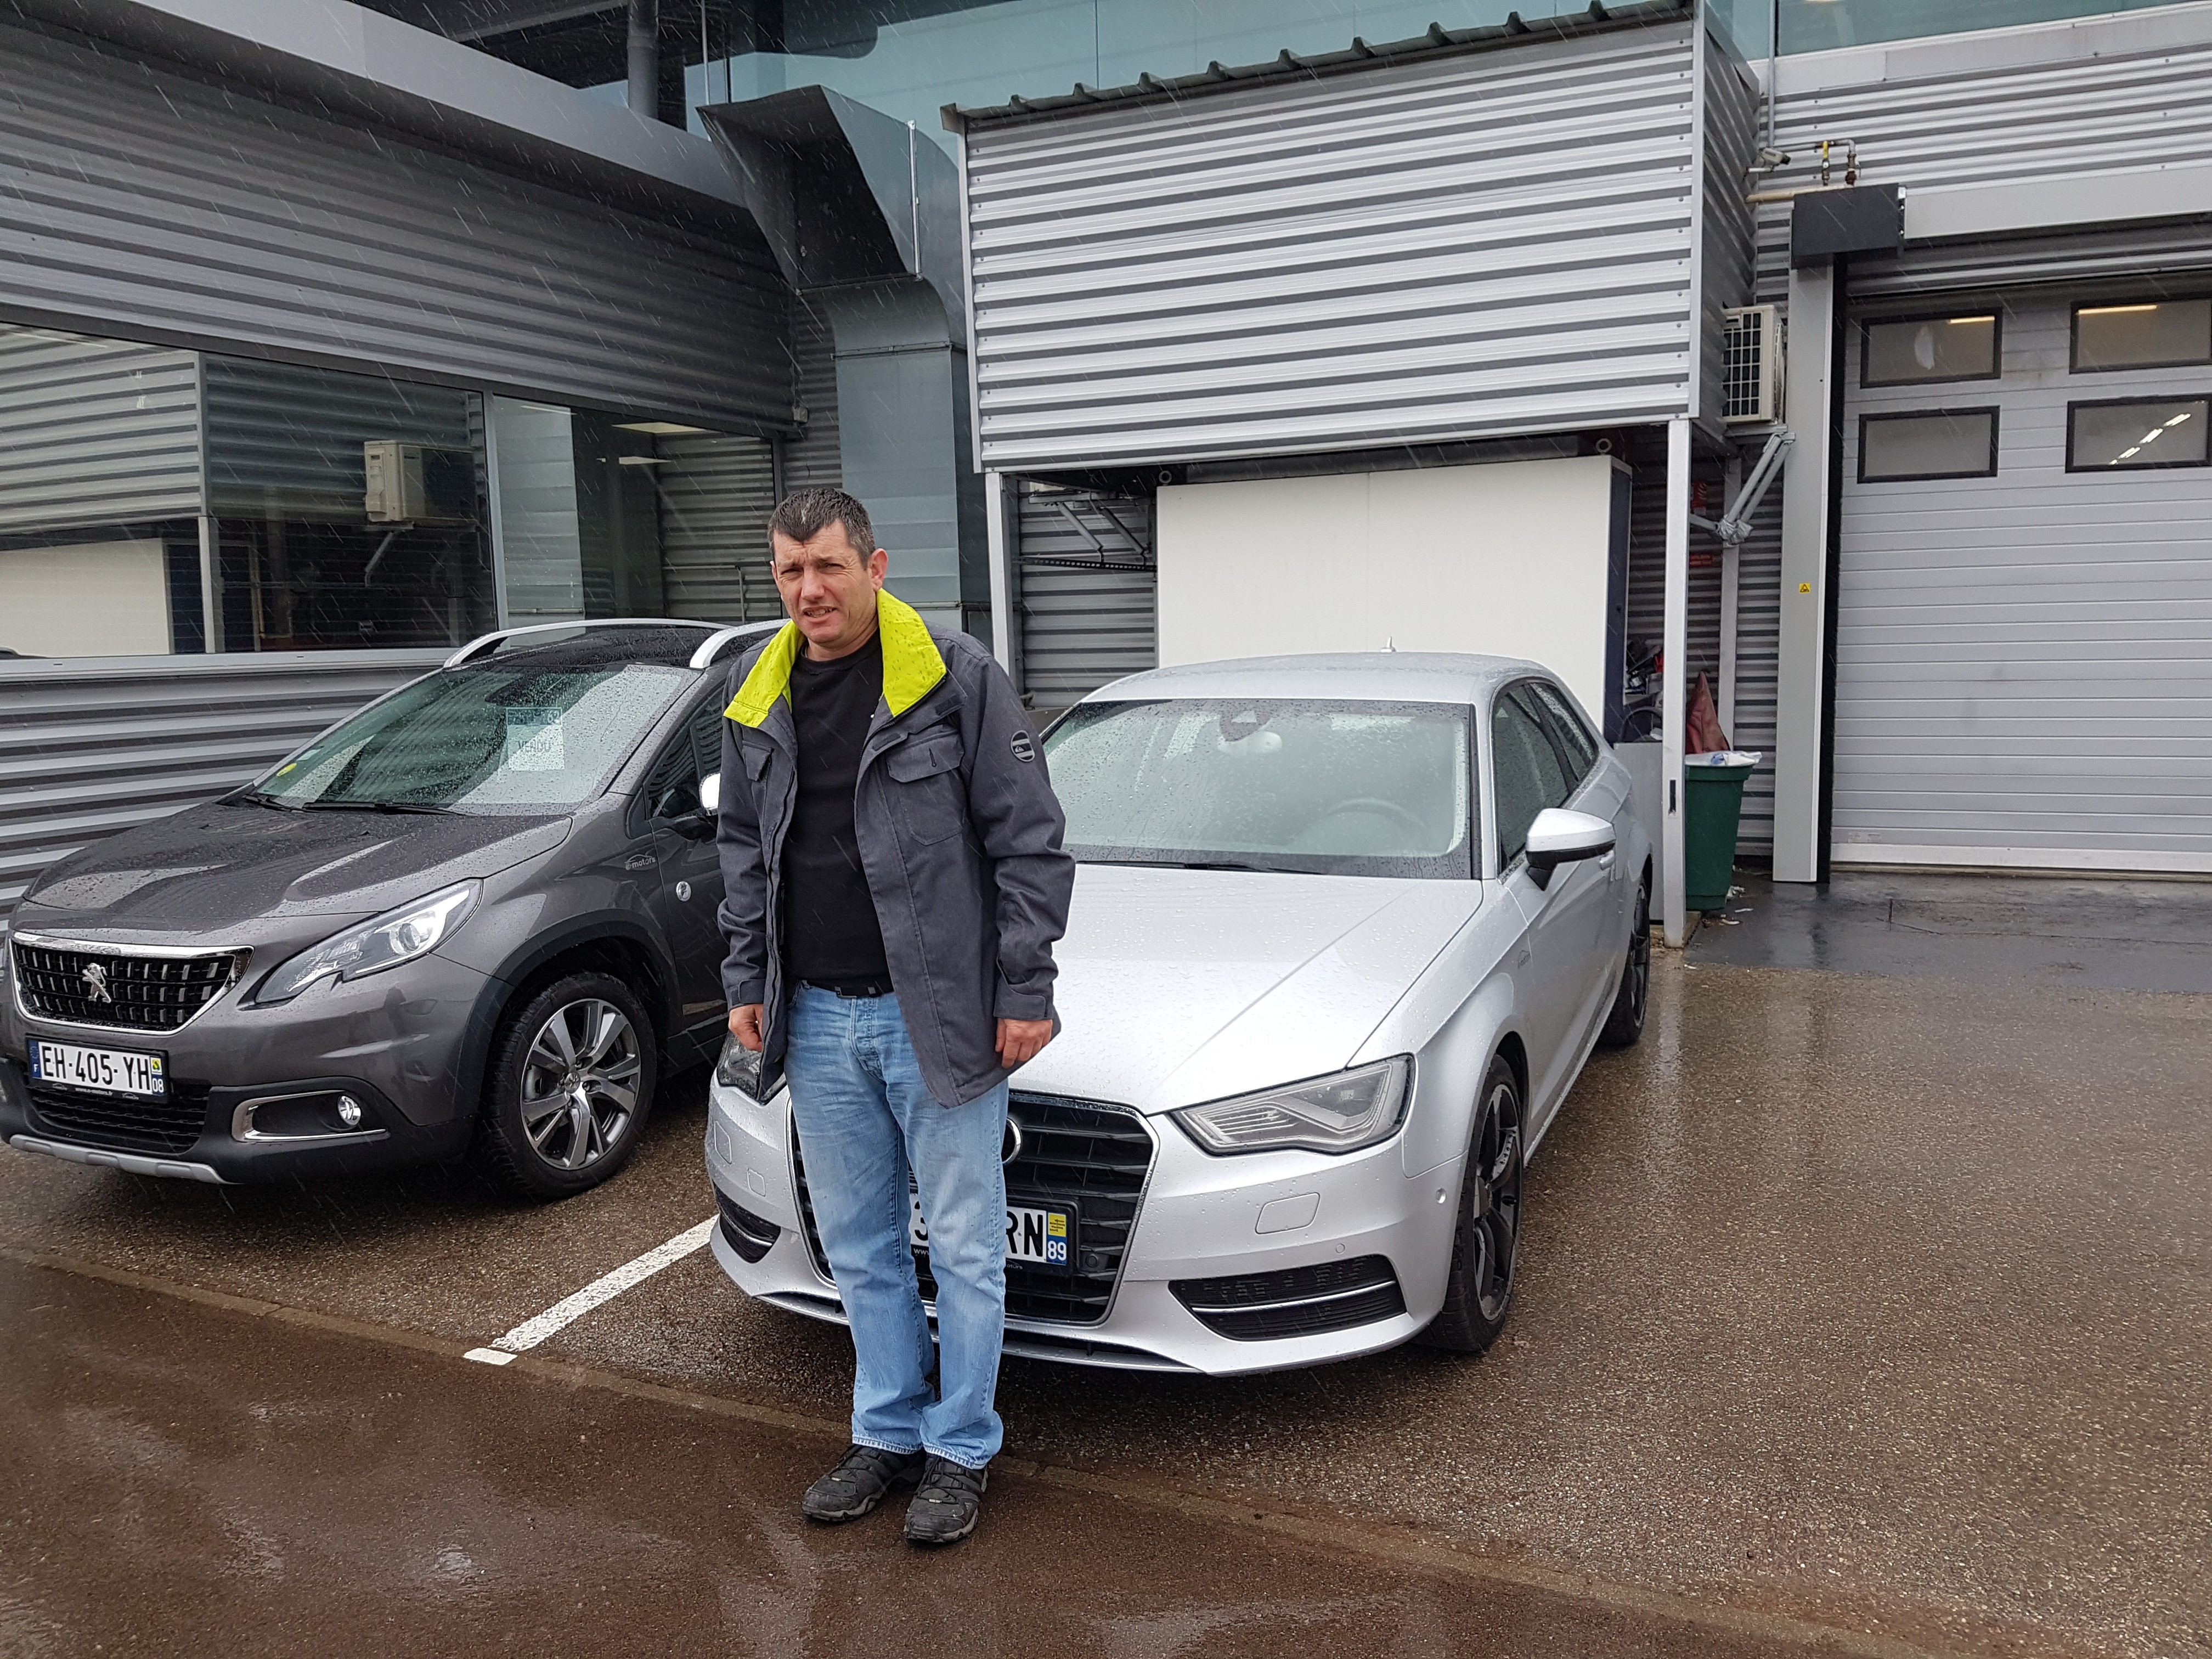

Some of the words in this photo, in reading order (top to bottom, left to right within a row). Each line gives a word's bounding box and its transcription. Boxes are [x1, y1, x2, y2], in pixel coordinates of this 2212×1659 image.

[517, 740, 551, 753] VENDU
[153, 1077, 164, 1093] 08
[1047, 1240, 1066, 1261] 89
